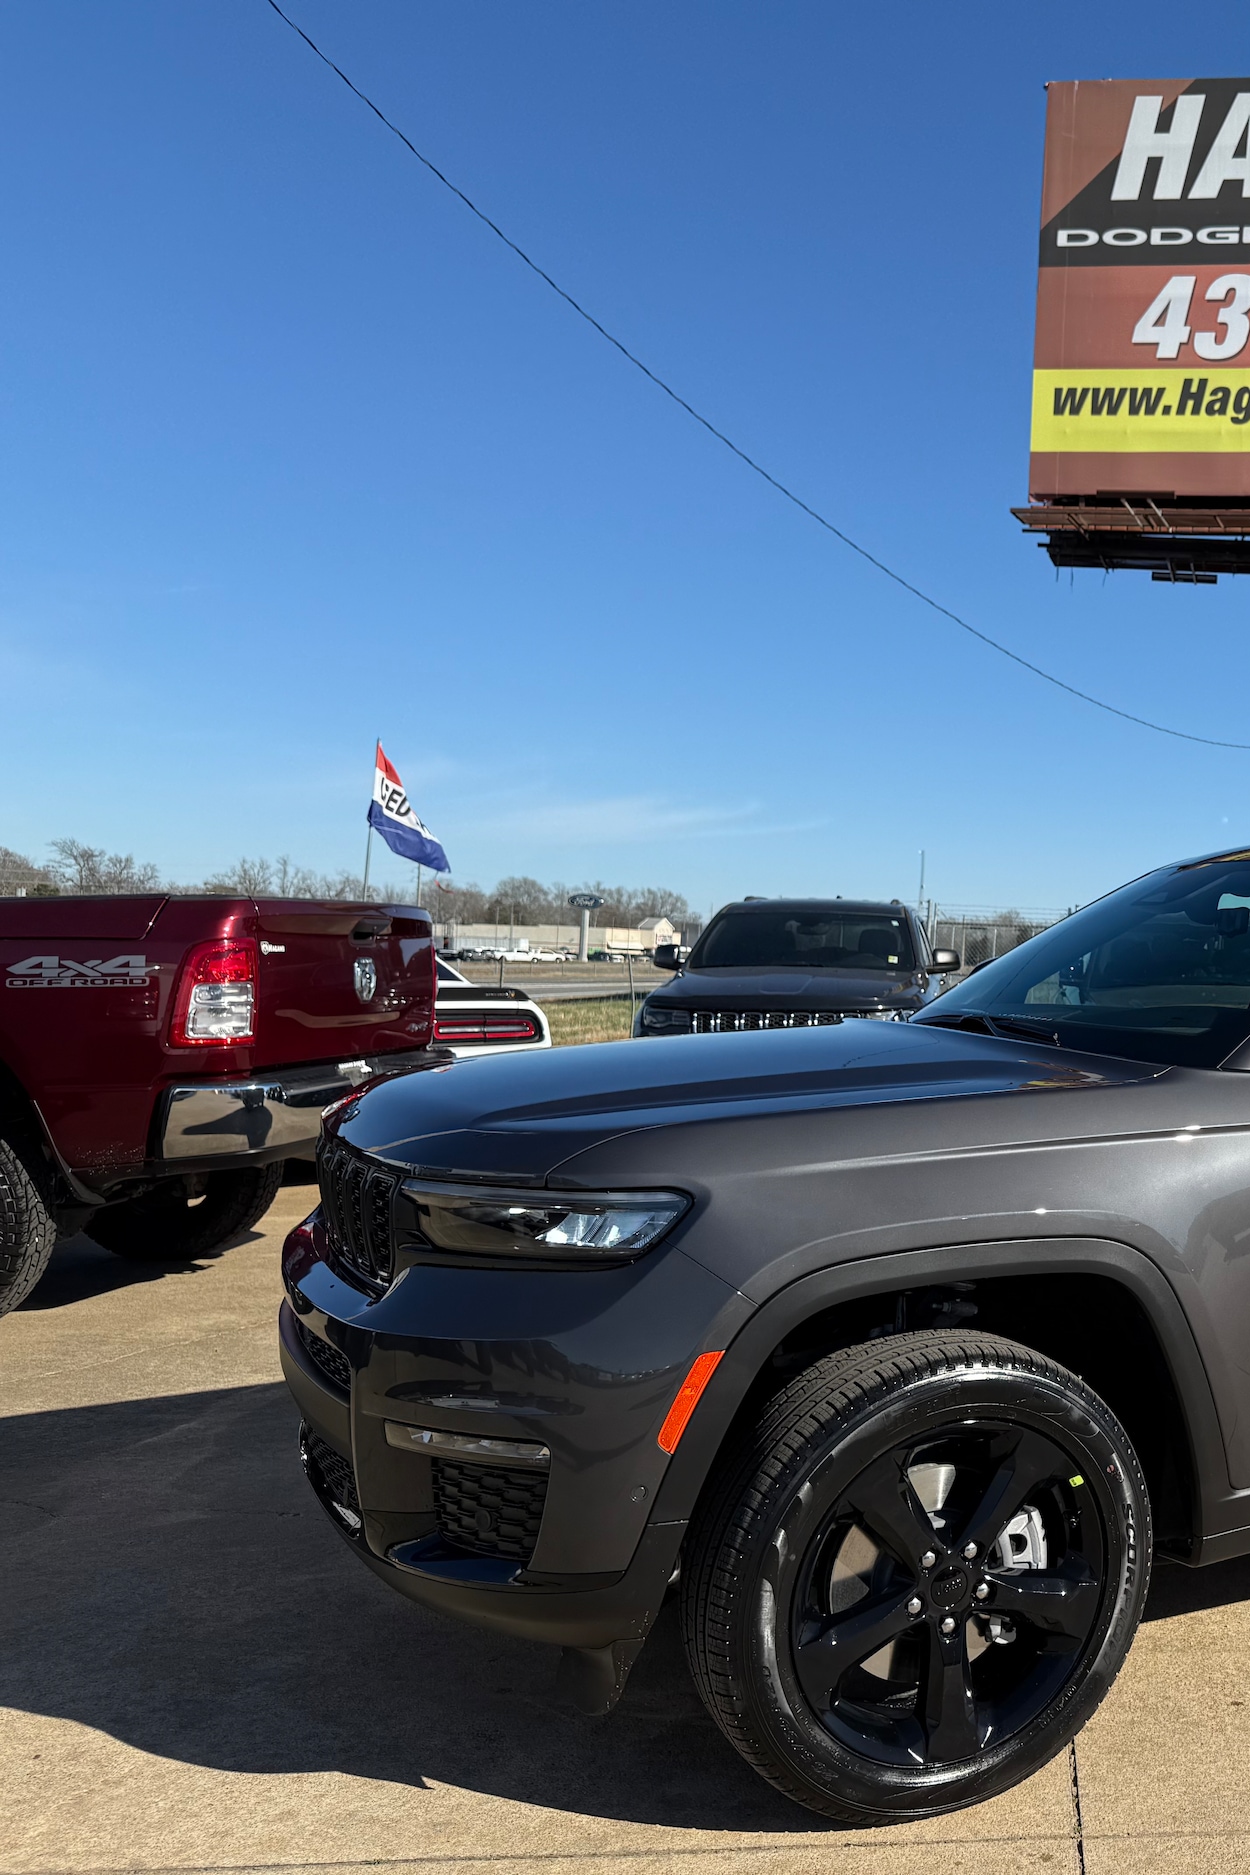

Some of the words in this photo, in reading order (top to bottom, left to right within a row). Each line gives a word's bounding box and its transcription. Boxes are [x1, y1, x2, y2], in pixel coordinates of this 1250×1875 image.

[8, 979, 64, 987] OFF
[70, 978, 147, 986] ROAD
[1103, 1503, 1138, 1667] SCORPION
